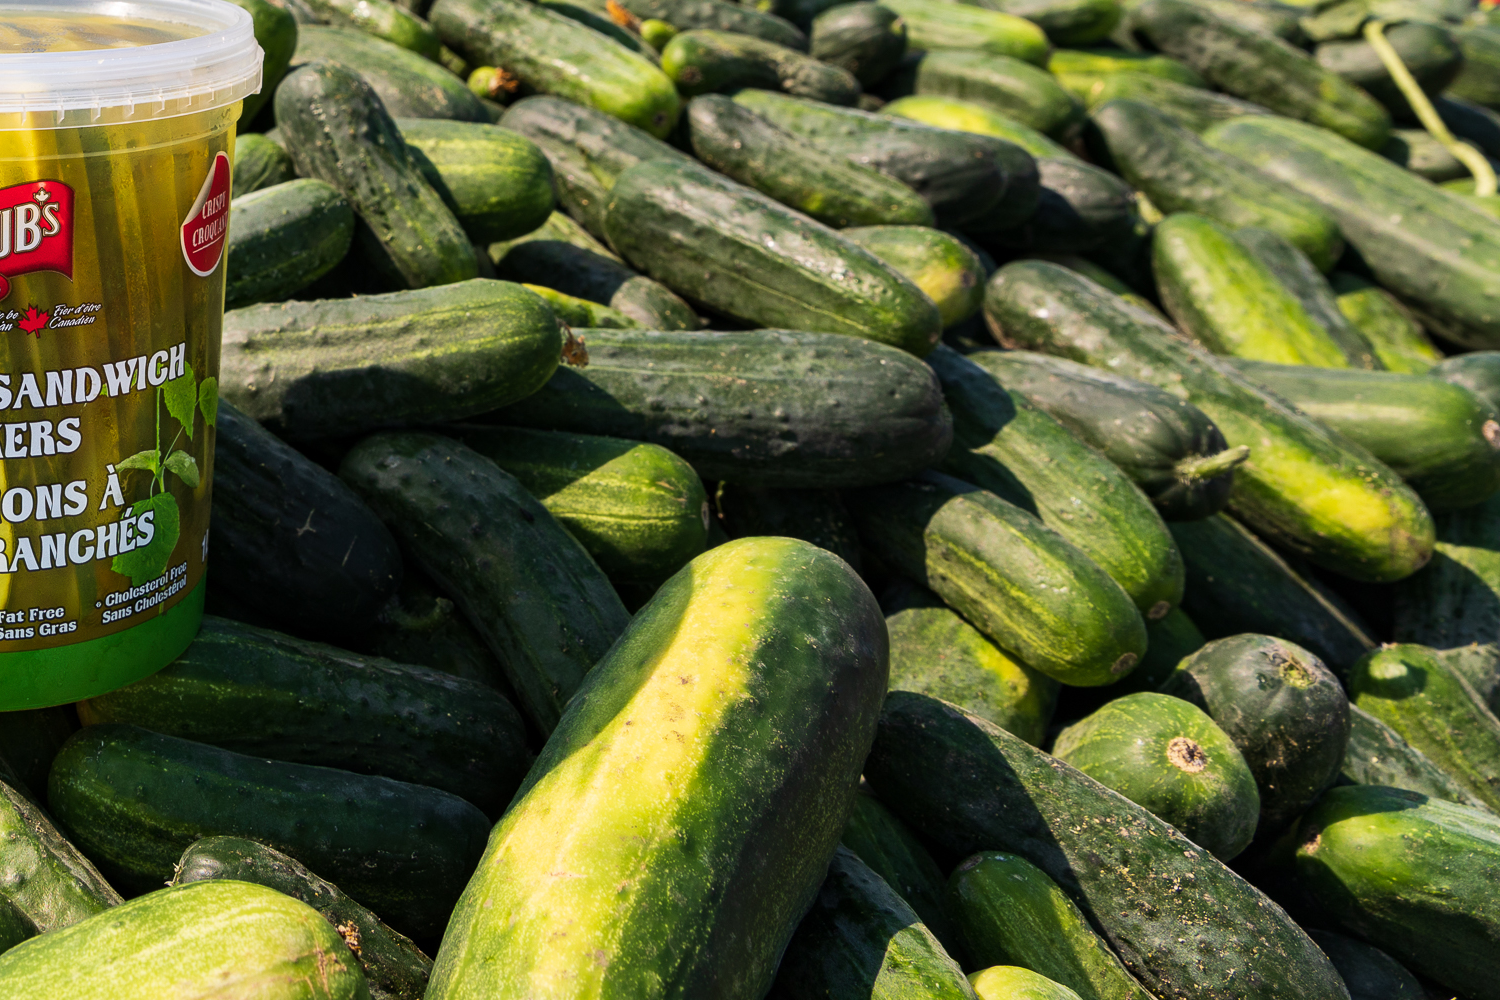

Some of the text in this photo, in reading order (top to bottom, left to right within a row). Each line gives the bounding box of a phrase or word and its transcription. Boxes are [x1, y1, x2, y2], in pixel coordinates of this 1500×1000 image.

[202, 190, 226, 219] CRISPY
[192, 211, 228, 247] CROQUANT
[6, 309, 19, 321] be
[54, 304, 74, 317] Fier
[49, 315, 97, 329] Canadien
[98, 463, 126, 511] À
[104, 561, 187, 607] Cholesterol Free
[102, 574, 187, 624] Sans Cholestérol
[29, 607, 65, 621] Free
[39, 621, 77, 636] Gras
